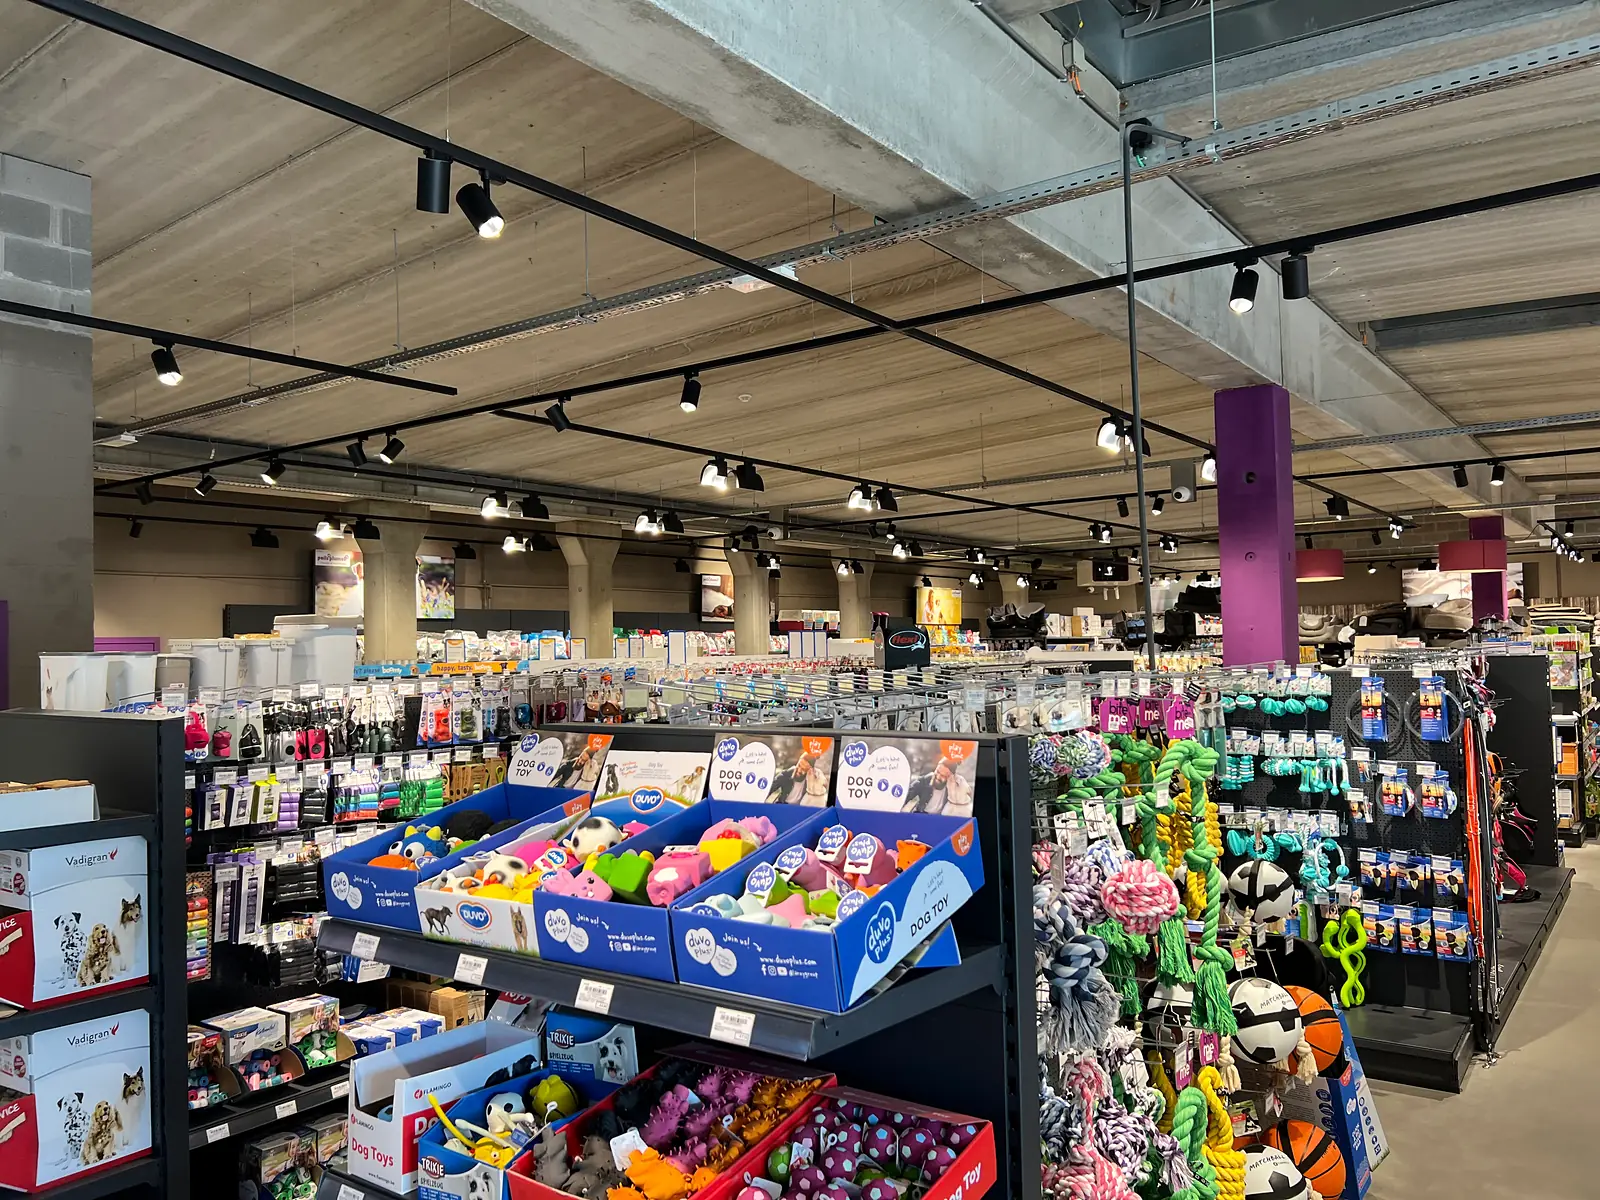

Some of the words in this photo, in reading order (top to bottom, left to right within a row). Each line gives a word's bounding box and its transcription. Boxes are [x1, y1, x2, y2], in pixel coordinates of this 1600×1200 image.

[892, 634, 919, 644] flexi
[1109, 701, 1128, 715] bite
[1145, 699, 1159, 710] bite
[1108, 714, 1128, 726] me
[1144, 709, 1160, 721] me
[1174, 718, 1190, 731] me
[719, 742, 735, 752] duvo
[809, 740, 821, 748] play
[846, 744, 864, 756] duvo
[949, 743, 962, 753] play
[721, 750, 734, 759] plus
[849, 753, 863, 763] plus
[950, 751, 963, 759] time
[517, 760, 535, 768] DOG
[516, 768, 532, 777] TOY
[719, 770, 742, 780] DOG
[720, 781, 740, 791] TOY
[847, 776, 873, 787] DOG
[848, 788, 870, 799] TOY
[823, 834, 843, 846] duvo
[851, 844, 874, 856] duvo
[65, 853, 108, 867] Vadigran
[781, 855, 805, 868] duvo
[333, 877, 347, 888] duvo
[750, 876, 772, 888] duvo
[547, 914, 567, 927] duvo
[576, 912, 590, 923] Join
[590, 916, 599, 928] us!
[910, 911, 931, 937] DOG
[932, 894, 949, 917] TOY
[0, 918, 17, 932] ICE
[552, 925, 567, 937] plus
[868, 917, 891, 951] duvo
[688, 933, 711, 948] duvo
[722, 933, 739, 944] Join
[739, 936, 750, 949] us!
[693, 946, 711, 958] plus
[874, 934, 891, 961] plus
[759, 954, 817, 967] www.duvoplus.com
[67, 1030, 110, 1046] Vadigran
[549, 1031, 574, 1046] TRIXIE
[549, 1052, 574, 1061] SPIELZEUG
[1179, 1063, 1190, 1081] me
[424, 1082, 452, 1095] FLAMINGO
[355, 1118, 374, 1131] FLAMINGO
[414, 1116, 438, 1136] Do
[351, 1137, 369, 1160] Dog
[370, 1146, 394, 1168] Toys
[421, 1157, 445, 1177] TRIXIE
[1249, 1155, 1286, 1172] MATCHBALL
[962, 1162, 981, 1190] Toy
[420, 1177, 444, 1189] SPIELZEUG
